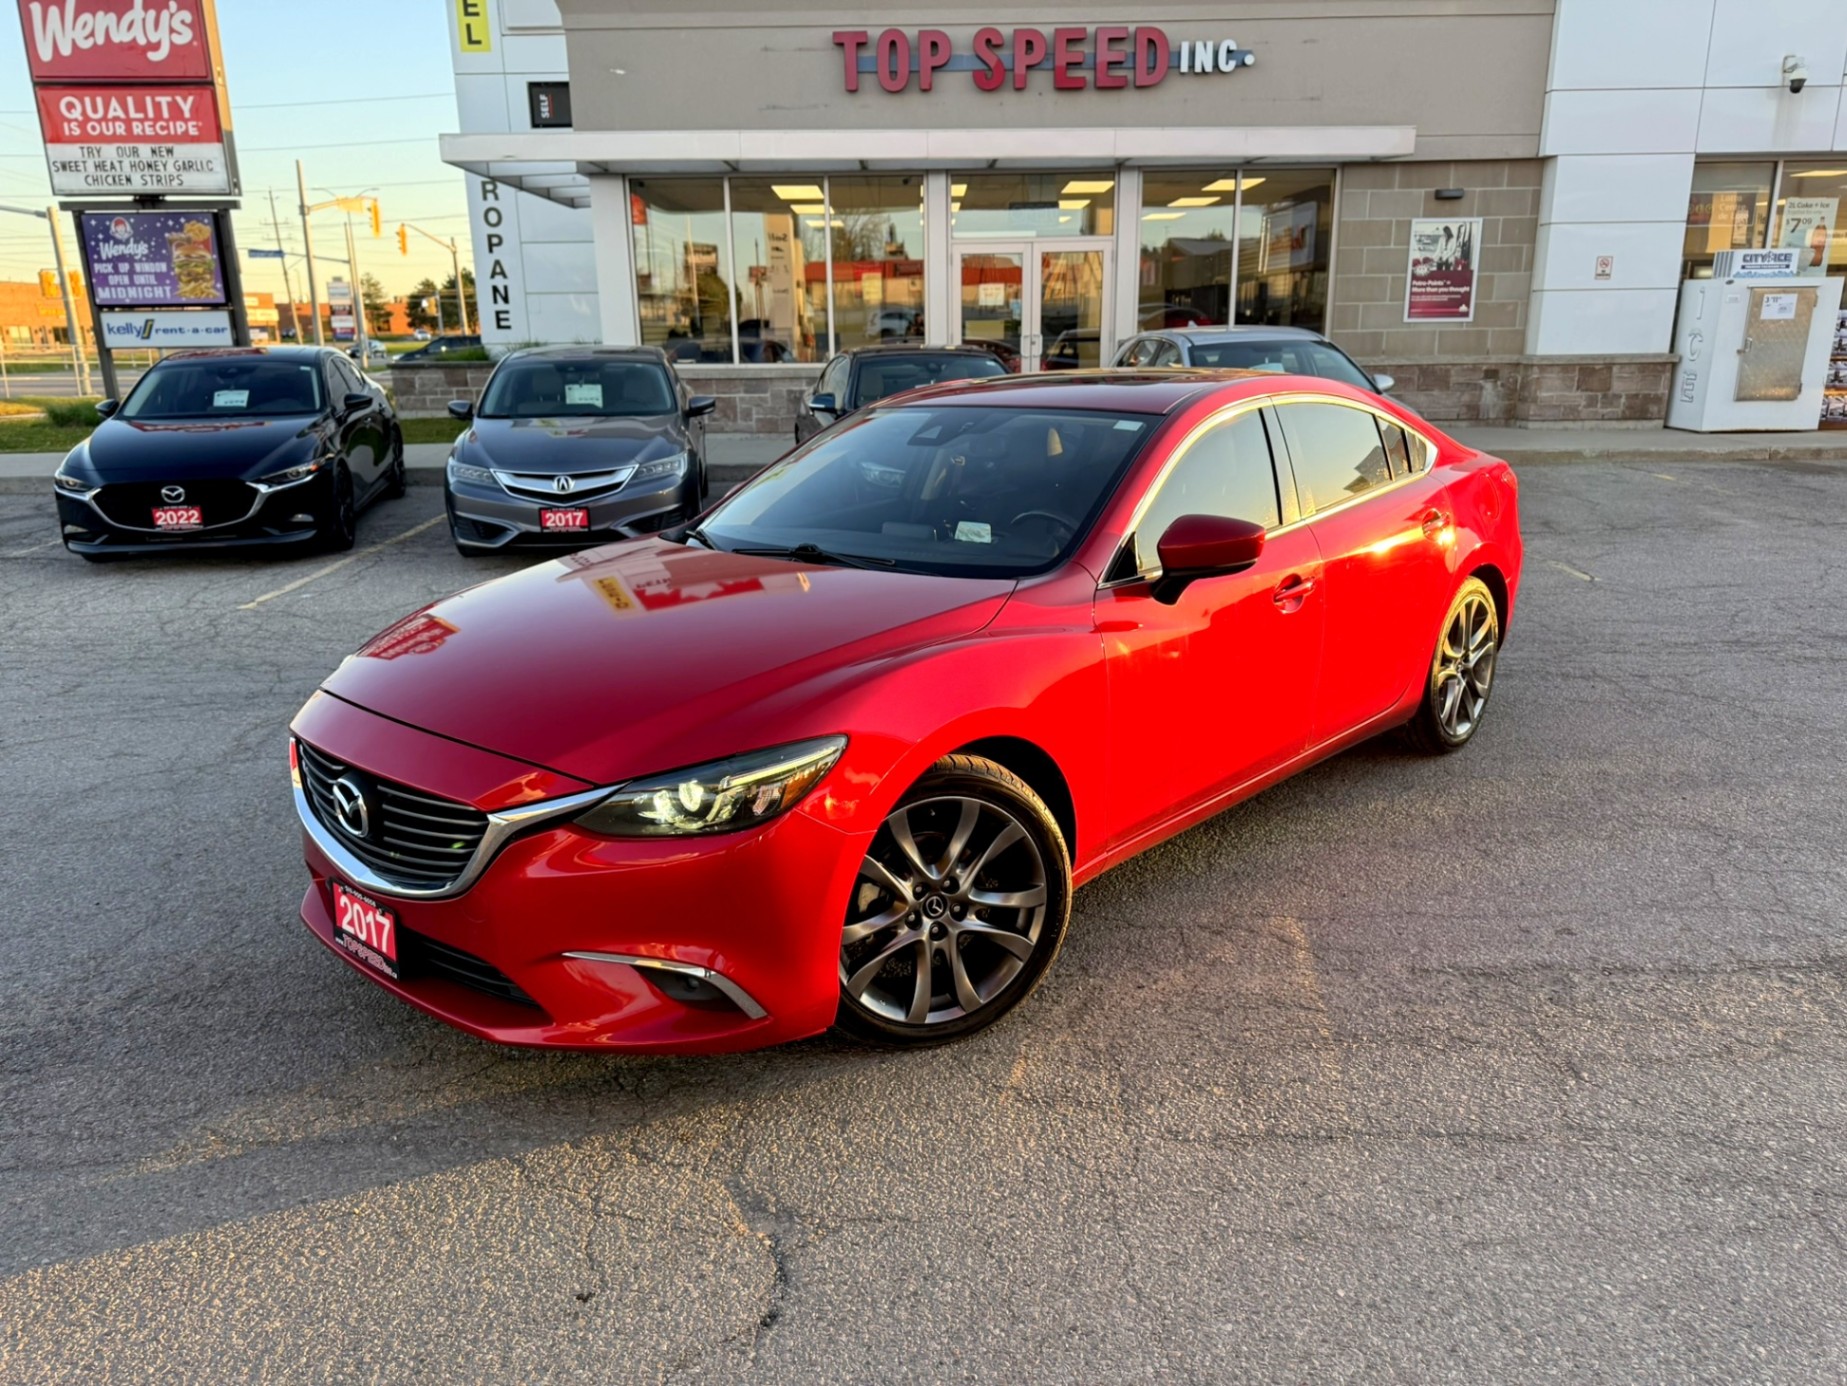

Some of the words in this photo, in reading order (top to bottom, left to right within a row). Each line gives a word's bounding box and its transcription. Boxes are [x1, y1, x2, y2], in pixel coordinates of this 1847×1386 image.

[29, 0, 193, 62] Wendy's
[832, 28, 952, 93] TOP
[972, 26, 1170, 92] SPEED
[59, 96, 195, 121] QUALITY
[540, 94, 550, 118] SELF
[63, 121, 81, 136] IS
[86, 121, 127, 136] OUR
[132, 121, 200, 136] RECIPE
[79, 146, 102, 158] TRY
[116, 146, 140, 158] OUR
[151, 146, 175, 158] NEW
[52, 160, 88, 173] SWEET
[94, 160, 124, 173] HEAT
[130, 160, 168, 172] HONEY
[84, 174, 133, 187] CHICKEN
[140, 174, 184, 186] STRIPS
[99, 238, 149, 260] Wendy's
[481, 180, 512, 330] ROPANE
[1742, 253, 1766, 263] CITY
[93, 262, 114, 274] PICK
[118, 262, 130, 274] UP
[134, 262, 167, 273] WINDOW
[108, 274, 130, 286] OPEN
[133, 274, 158, 285] UNTIL
[97, 286, 172, 300] MIDNIGHT
[106, 322, 143, 338] kelly
[155, 510, 201, 525] 2022
[545, 511, 584, 527] 2017
[340, 895, 391, 954] 2017
